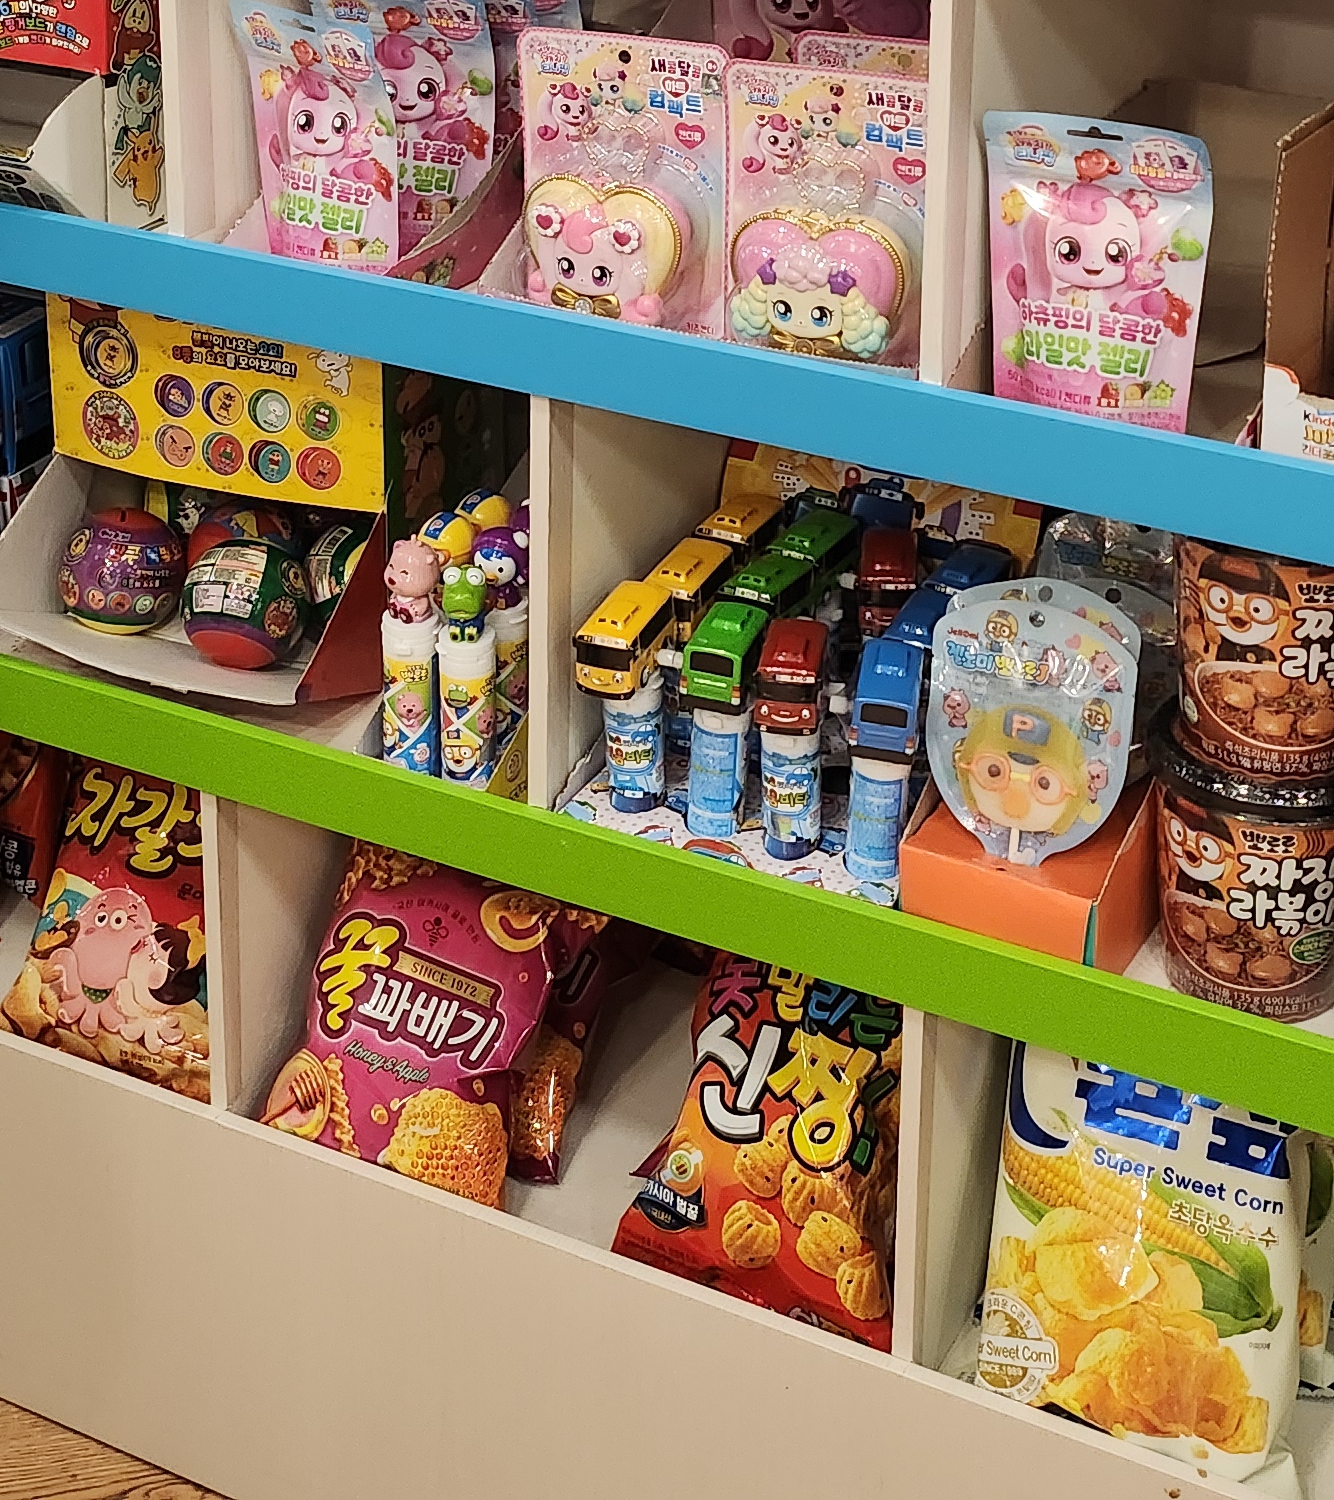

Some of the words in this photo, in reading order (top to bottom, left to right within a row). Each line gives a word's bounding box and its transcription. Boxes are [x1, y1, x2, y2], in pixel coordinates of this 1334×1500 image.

[650, 57, 703, 79] 새콤달콤
[648, 88, 703, 119] 컴팩트
[867, 91, 924, 114] 새콤달콤
[865, 122, 925, 152] 컴팩트
[412, 141, 467, 167] 달콤한
[320, 176, 374, 206] 달콤한
[411, 163, 455, 195] 젤리
[319, 200, 366, 235] 젤리
[1019, 299, 1093, 333] 하츄핑의
[1098, 311, 1163, 346] 달콤한
[225, 337, 257, 353] 나오는
[258, 341, 283, 358] 요요!
[1022, 328, 1093, 368] 과일맛
[1098, 344, 1152, 378] 젤리
[238, 355, 297, 378] 모아보세요!
[1281, 752, 1302, 764] 135
[1240, 829, 1296, 854] 뽀로로
[319, 918, 500, 1062] 꿀꽈배기
[410, 961, 448, 987] SINCE
[449, 976, 479, 998] 1972
[1232, 991, 1251, 1003] 135
[1261, 994, 1284, 1007] (490
[344, 1040, 385, 1073] Honey
[393, 1060, 431, 1084] Apple
[1093, 1146, 1155, 1181] Super
[1161, 1167, 1227, 1202] Sweet
[1234, 1188, 1285, 1215] Corn
[1167, 1198, 1280, 1250] 초당옥수수
[985, 1341, 1021, 1360] Sweet
[1021, 1343, 1052, 1365] Corn
